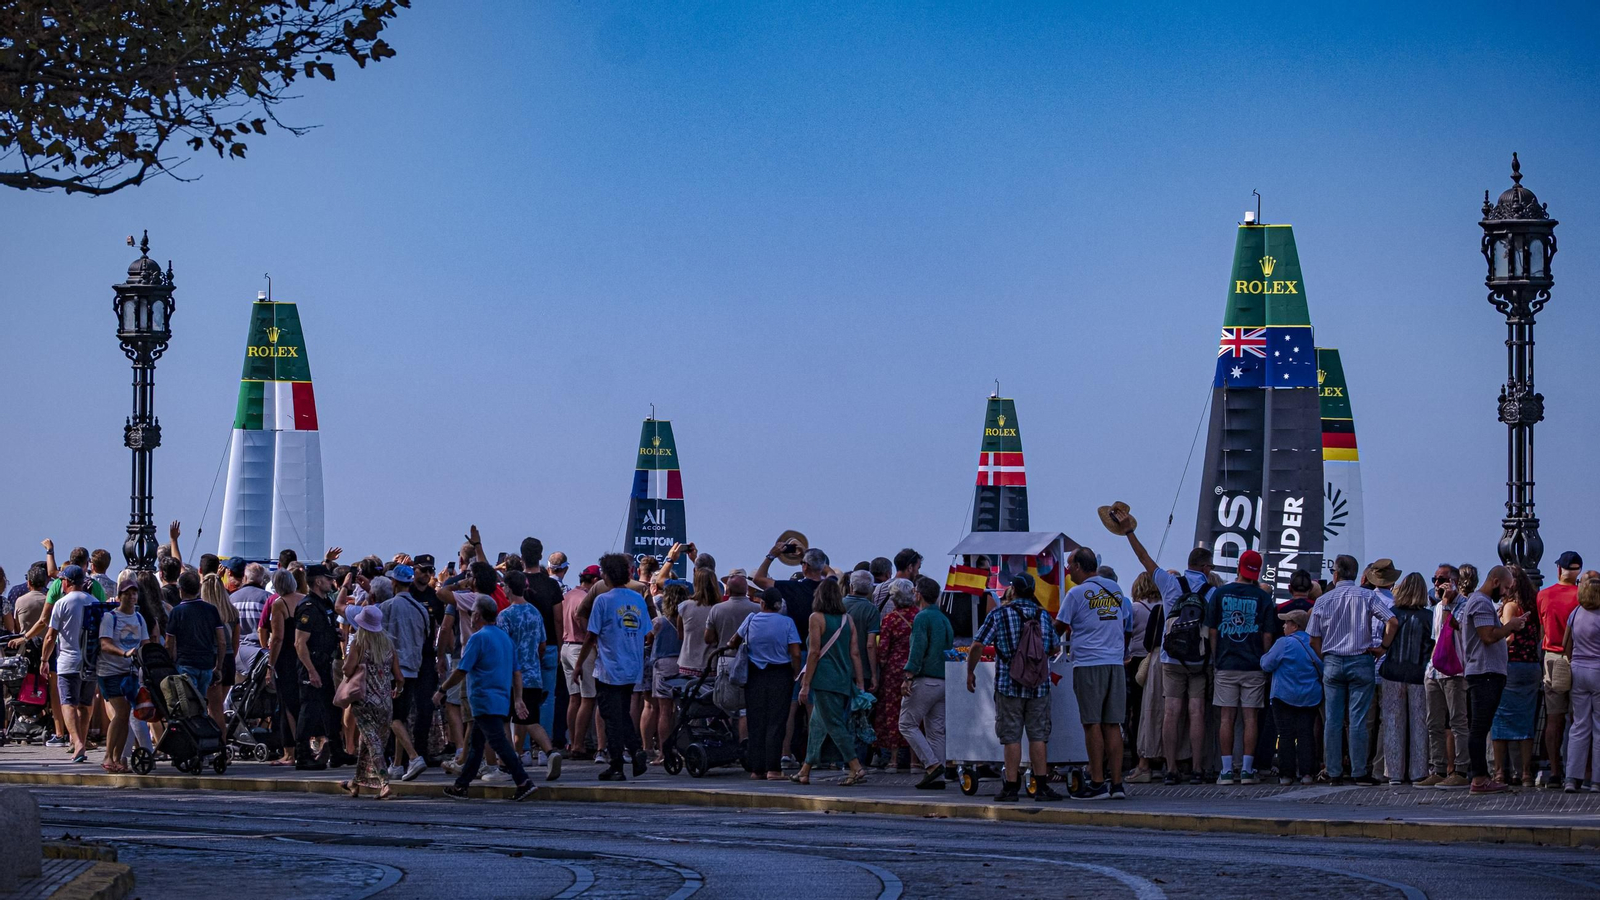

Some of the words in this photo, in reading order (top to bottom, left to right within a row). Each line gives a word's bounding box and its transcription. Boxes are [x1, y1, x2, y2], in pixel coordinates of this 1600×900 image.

[1235, 280, 1298, 294] ROLEX
[247, 346, 298, 357] ROLEX
[985, 428, 1016, 436] ROLEX
[640, 447, 672, 456] ROLEX
[635, 537, 674, 546] LEYTON
[1262, 564, 1276, 582] for
[1222, 597, 1257, 613] CREATED
